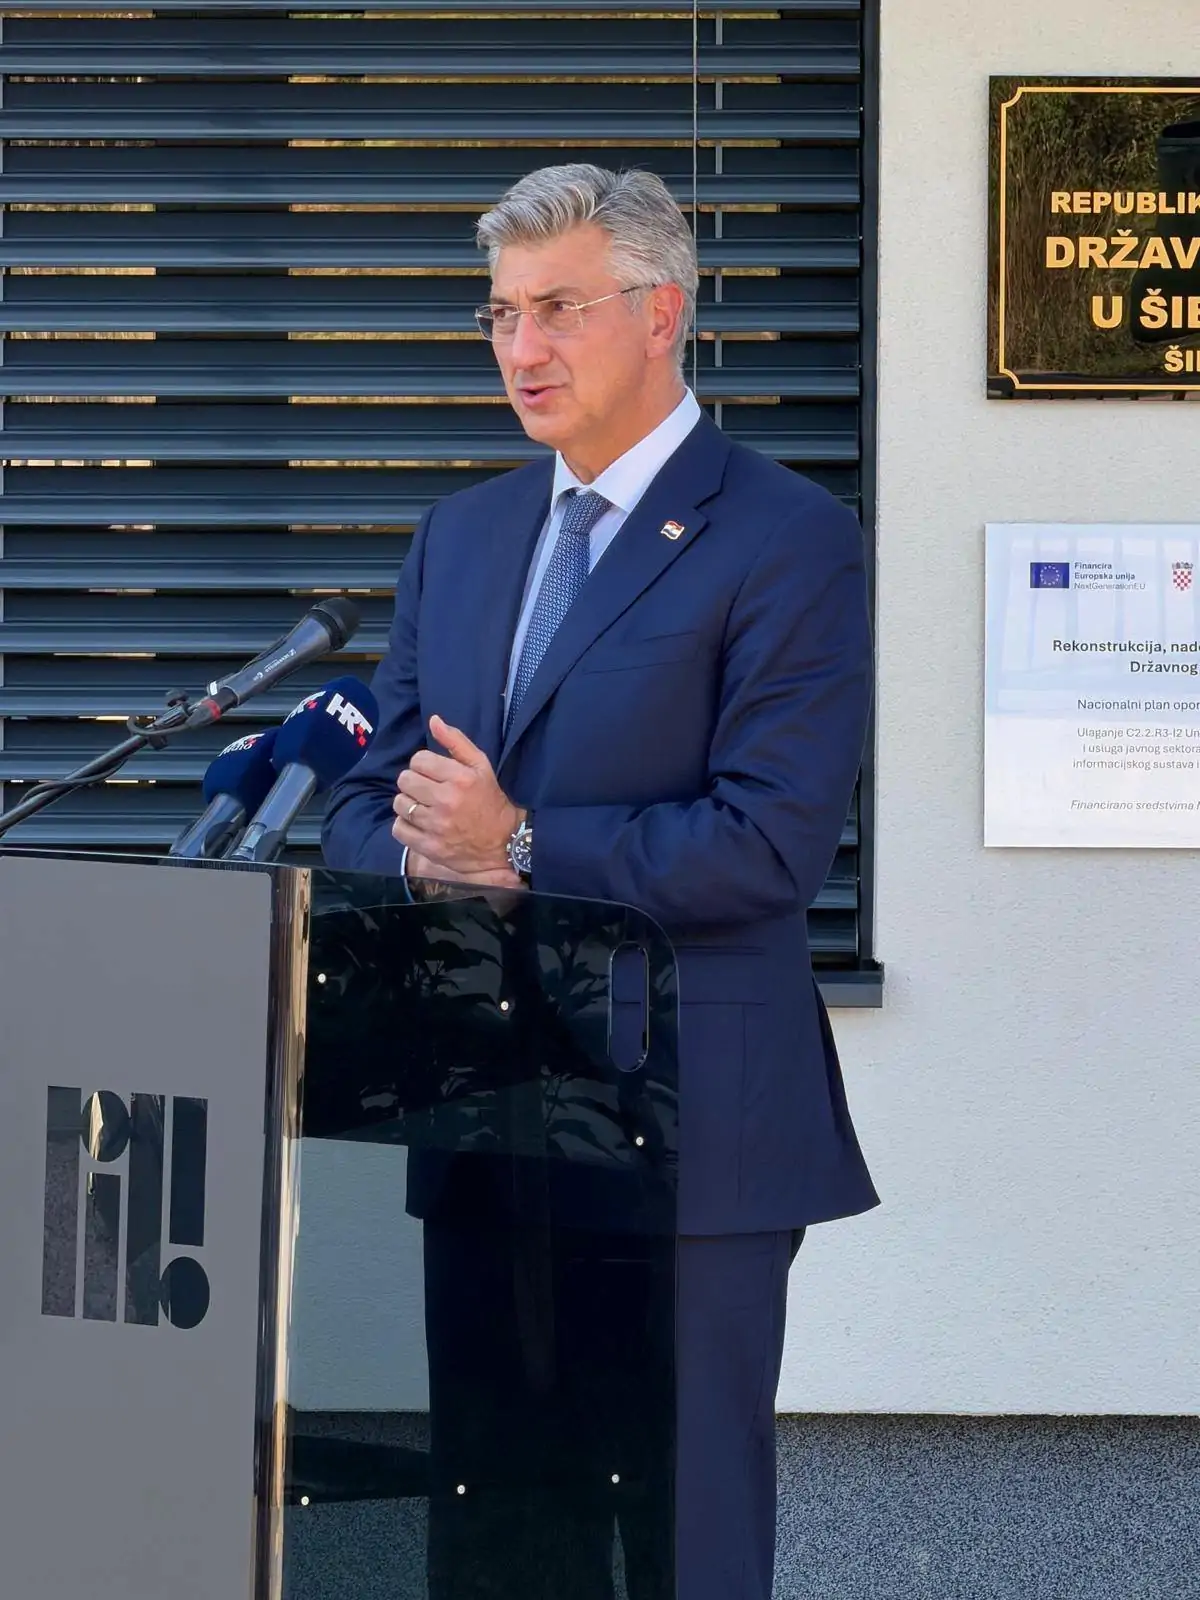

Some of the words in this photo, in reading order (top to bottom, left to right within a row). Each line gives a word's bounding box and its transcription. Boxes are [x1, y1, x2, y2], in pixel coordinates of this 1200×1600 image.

[1046, 229, 1200, 269] DRŽAV
[1092, 295, 1123, 329] U
[1164, 345, 1200, 372] ŠI
[1074, 562, 1112, 570] Financira
[1074, 572, 1113, 580] Europska
[1115, 572, 1136, 580] unija
[1053, 640, 1166, 654] Rekonstrukcija,
[1130, 660, 1198, 676] Državnog
[1077, 699, 1141, 710] Nacionalni
[1144, 699, 1170, 711] plan
[1077, 728, 1124, 739] Ulaganje
[1088, 743, 1123, 755] usluga
[1125, 744, 1161, 755] javnog
[1073, 760, 1151, 771] informacijskog
[1153, 760, 1194, 769] sustava
[1071, 800, 1133, 810] Financirano
[1136, 800, 1194, 810] sredstvima
